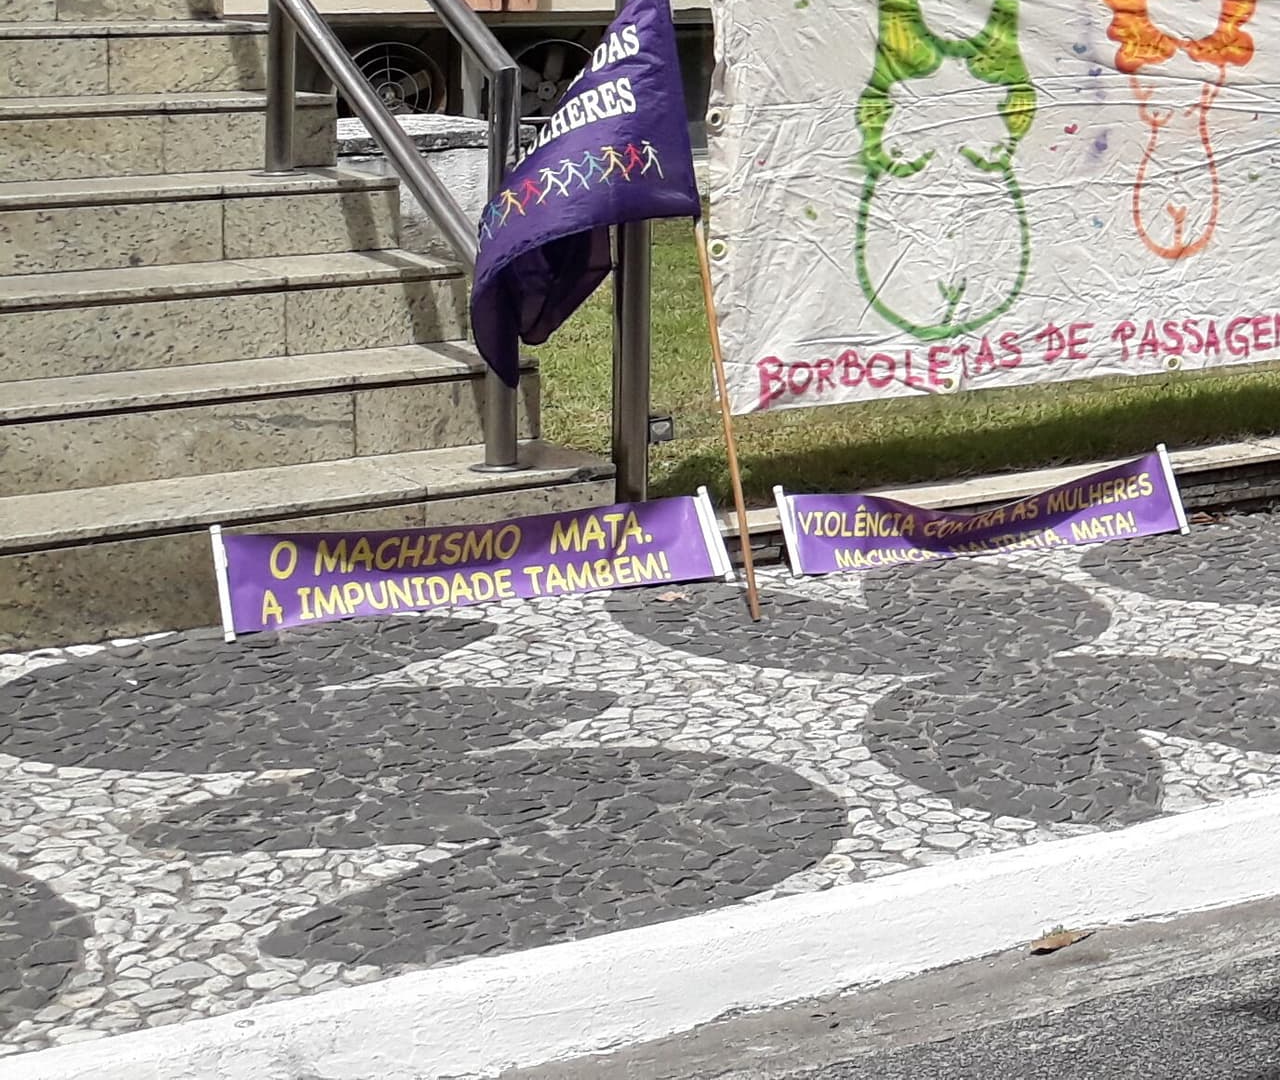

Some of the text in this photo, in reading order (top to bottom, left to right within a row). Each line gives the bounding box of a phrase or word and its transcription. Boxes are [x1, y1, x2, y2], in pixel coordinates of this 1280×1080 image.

[591, 24, 640, 72] DAS
[757, 331, 1022, 410] BORBOLETAS
[1036, 320, 1095, 364] DE
[798, 472, 1154, 538] VIOLÊNCIA CONTRA AS MULHERES
[1072, 511, 1138, 543] MATA!
[269, 510, 654, 580] O MACHISMO MATA.
[262, 589, 285, 624] A
[297, 566, 517, 619] IMPUNIDADE
